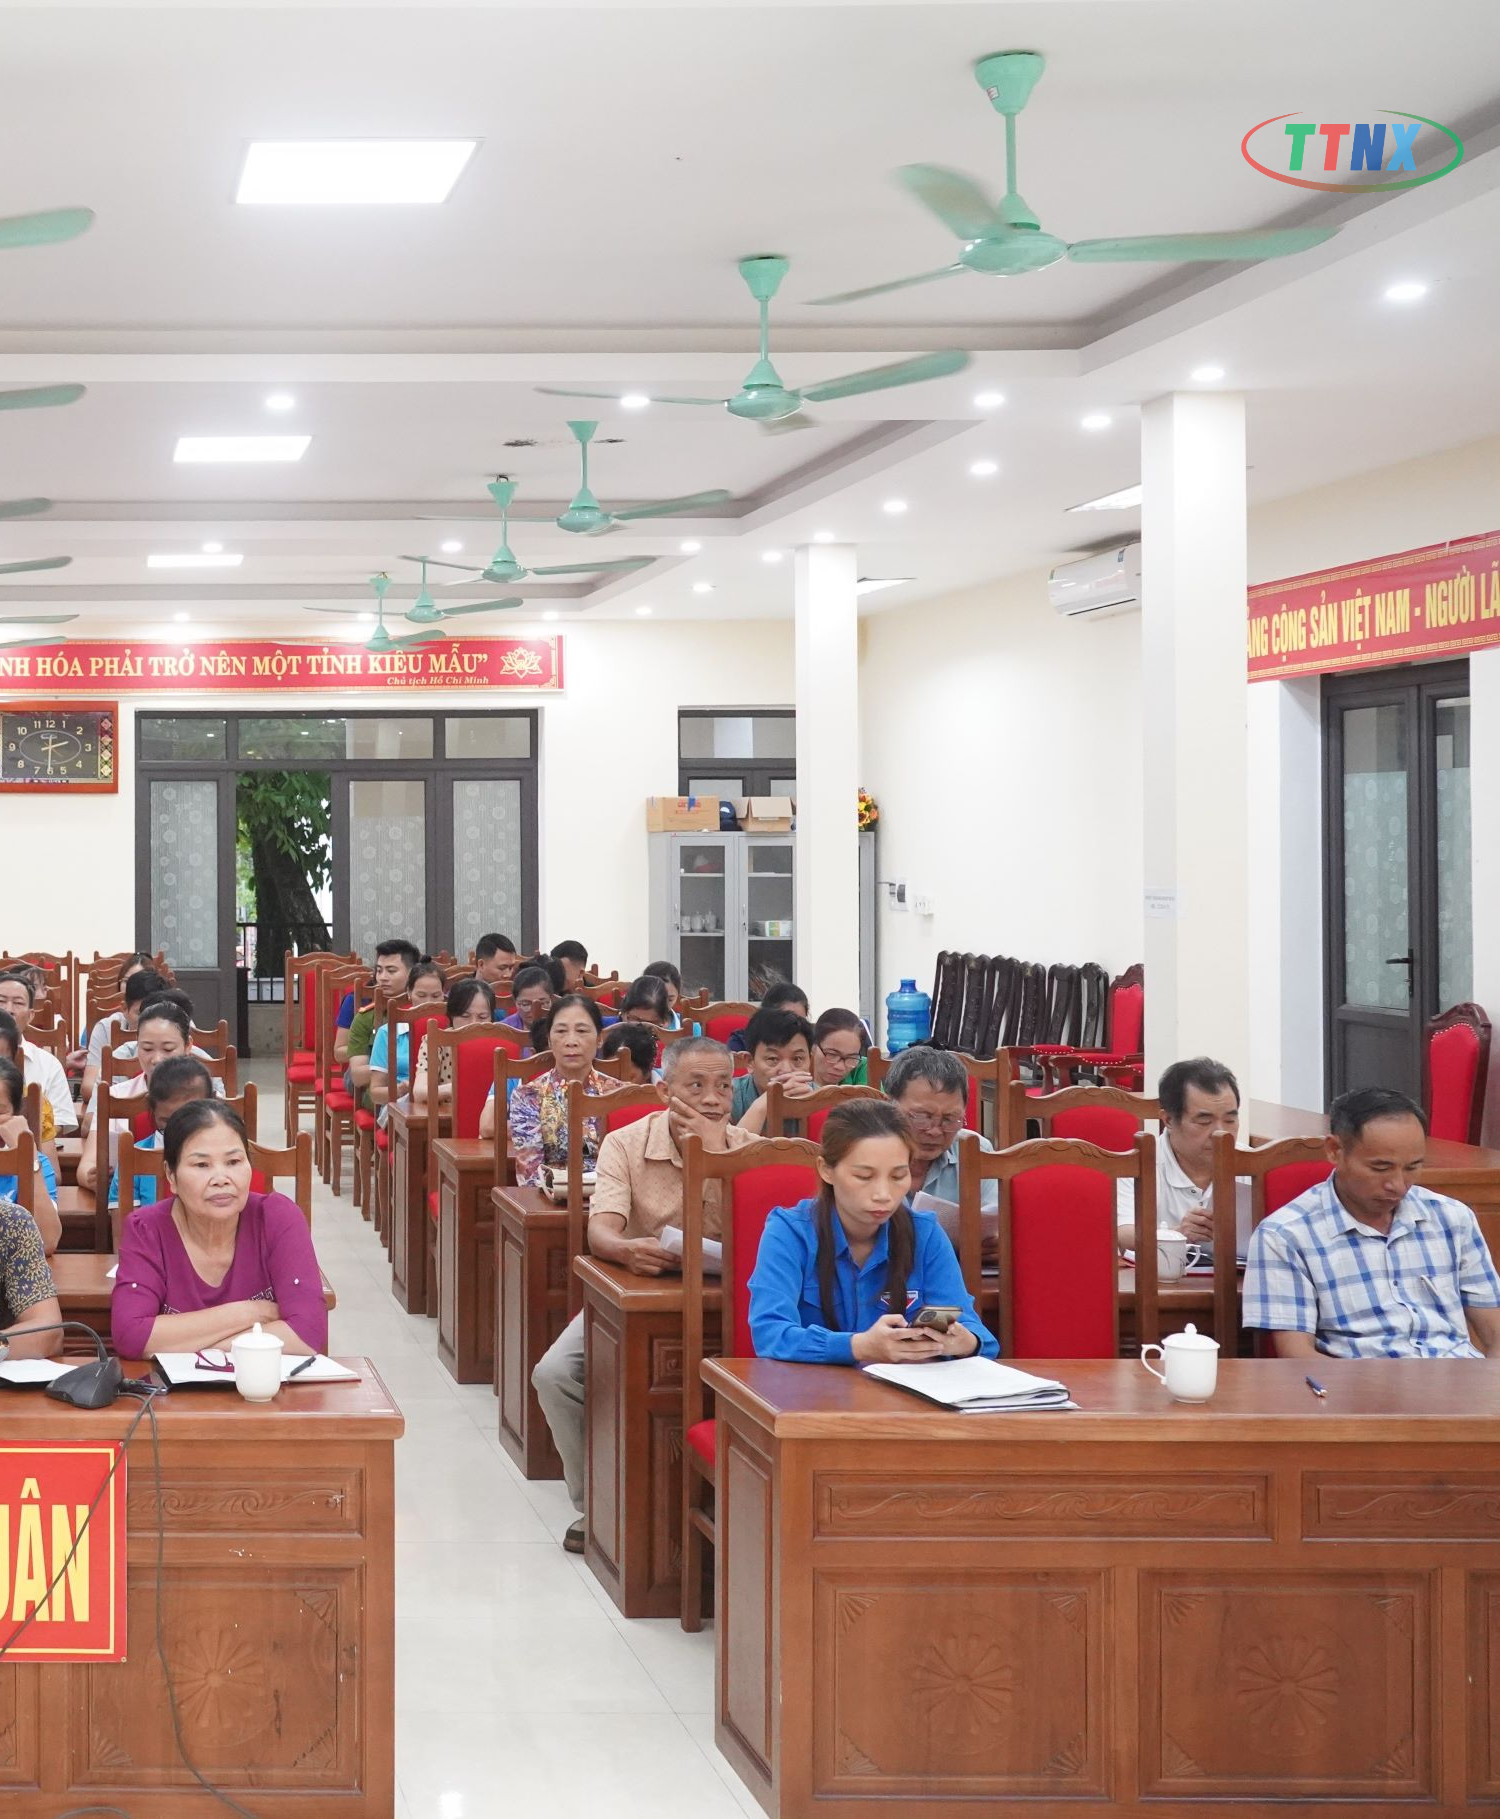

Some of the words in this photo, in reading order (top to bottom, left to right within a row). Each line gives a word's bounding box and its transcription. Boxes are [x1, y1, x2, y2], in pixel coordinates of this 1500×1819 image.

[1272, 603, 1307, 663] CỘNG
[1310, 590, 1338, 648] SẢN
[1341, 588, 1371, 650] VIỆT
[1375, 588, 1410, 637] NAM
[1425, 564, 1476, 629] NGƯỜI
[36, 651, 84, 677] HÓA
[89, 648, 144, 677] PHẢI
[148, 648, 195, 677] TRỞ
[200, 650, 247, 676] NÊN
[252, 649, 301, 681] MỘT
[307, 647, 362, 675] TỈNH
[428, 643, 488, 674] MẪU”
[463, 676, 489, 685] Minh
[34, 720, 41, 729] 11
[45, 720, 56, 729] 12
[17, 726, 28, 735] 10
[76, 726, 83, 735] 2
[8, 743, 16, 752] 9
[84, 743, 92, 752] 3
[17, 760, 25, 769] 8
[75, 760, 83, 769] 4
[34, 766, 41, 775] 7
[60, 766, 67, 775] 5
